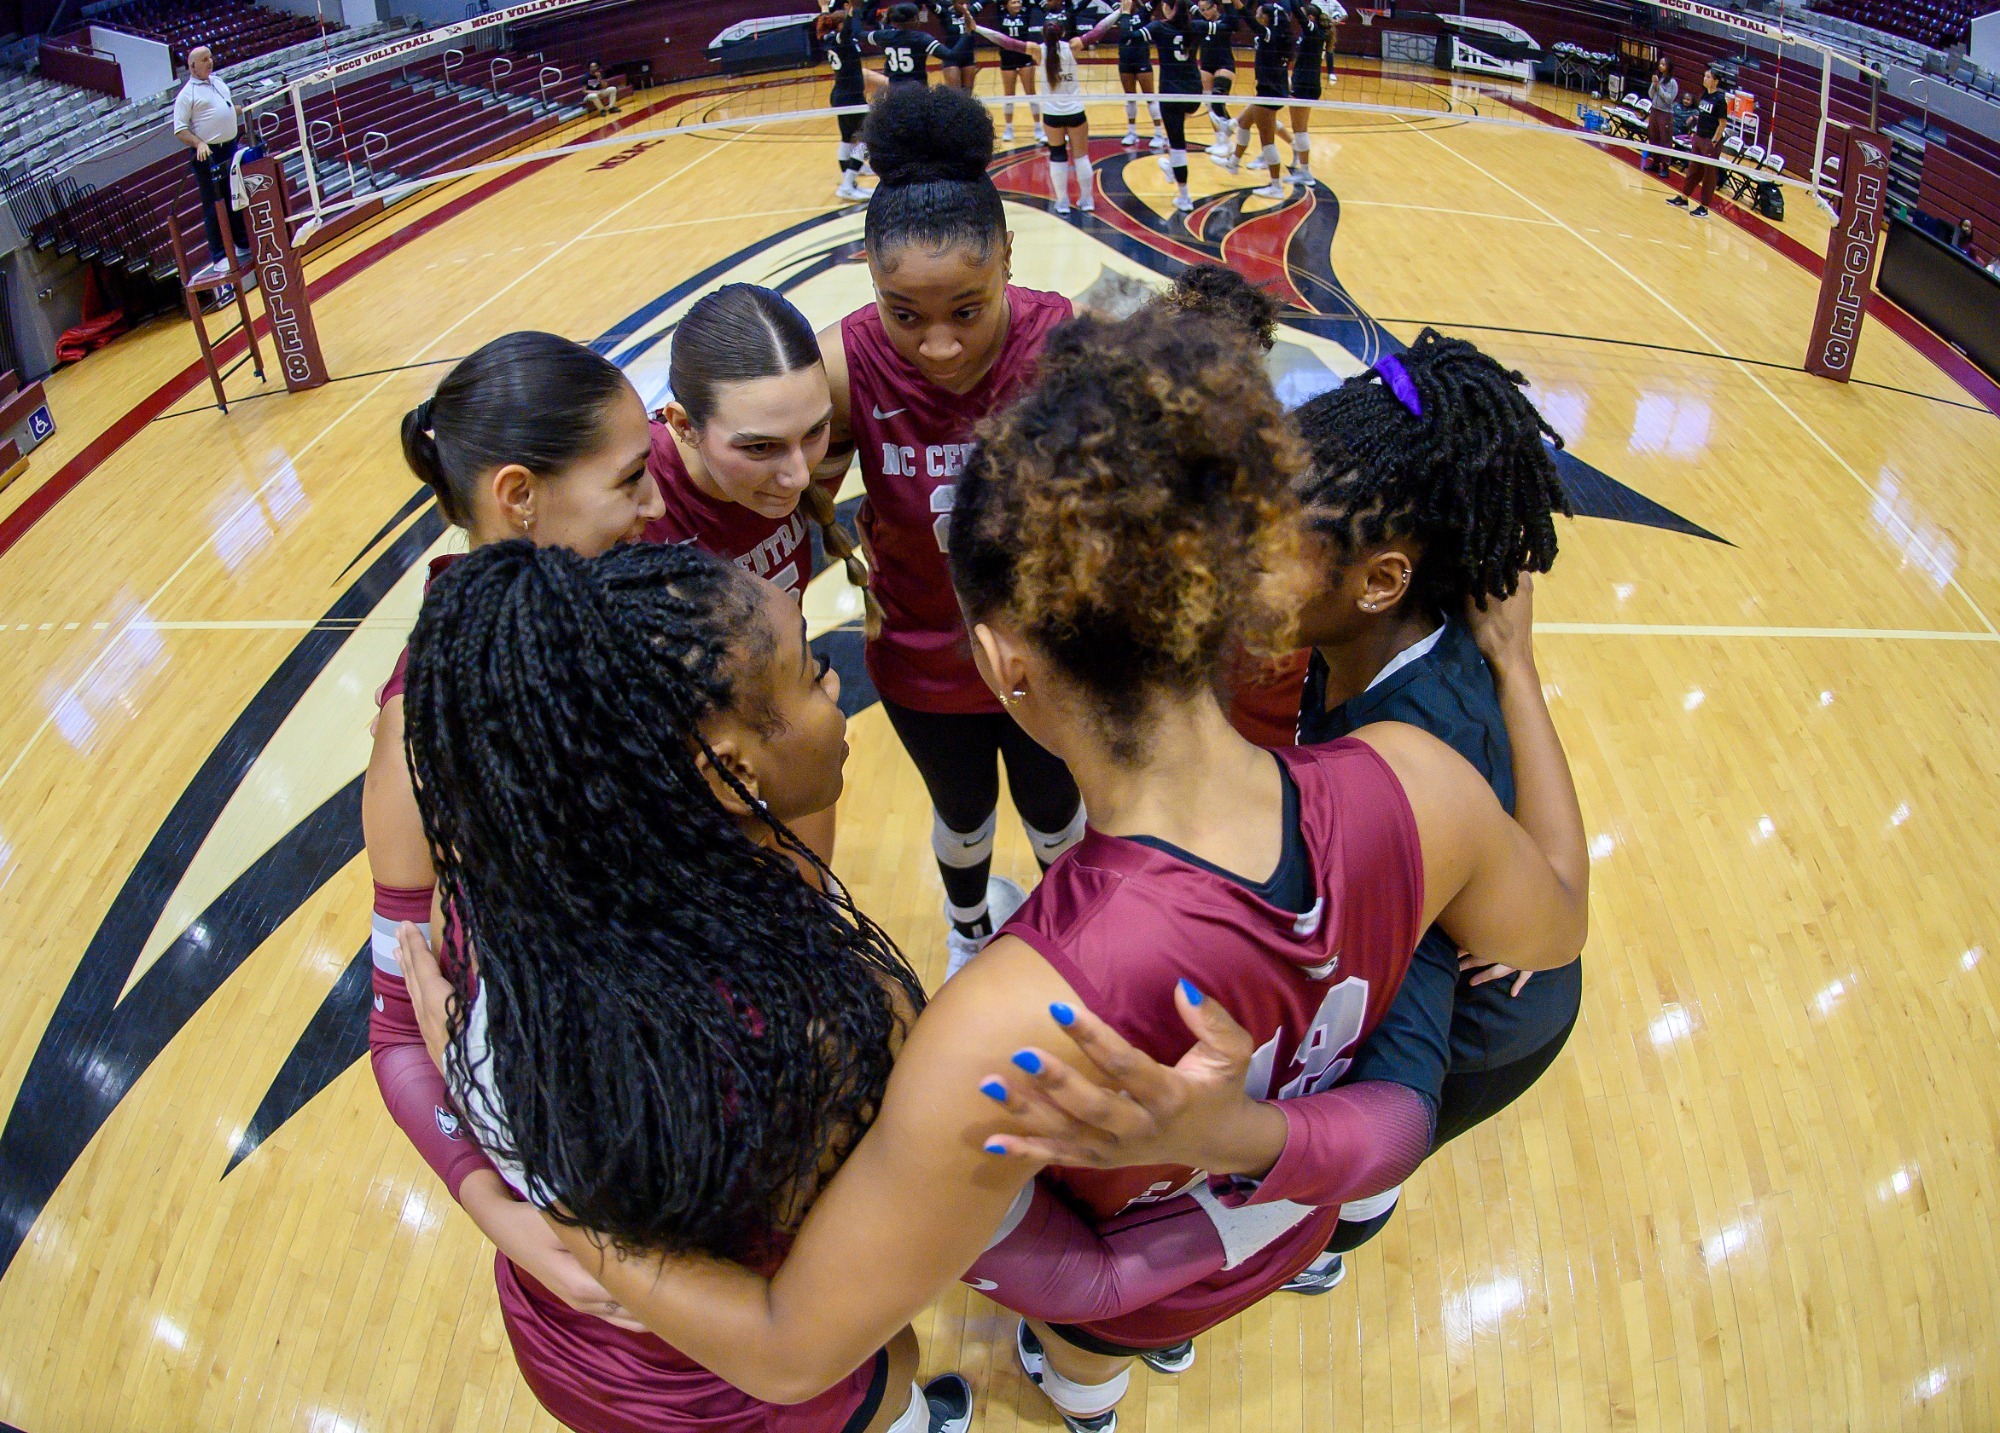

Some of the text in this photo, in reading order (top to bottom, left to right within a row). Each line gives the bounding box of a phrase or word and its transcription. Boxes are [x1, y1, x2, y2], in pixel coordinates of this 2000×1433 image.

[1694, 5, 1768, 34] VOLLEYBALL
[364, 34, 434, 62] VOLLEYBALL
[884, 46, 914, 73] 35
[1823, 174, 1880, 370] EAGLES
[249, 200, 311, 382] EAGLES
[882, 442, 916, 477] NC
